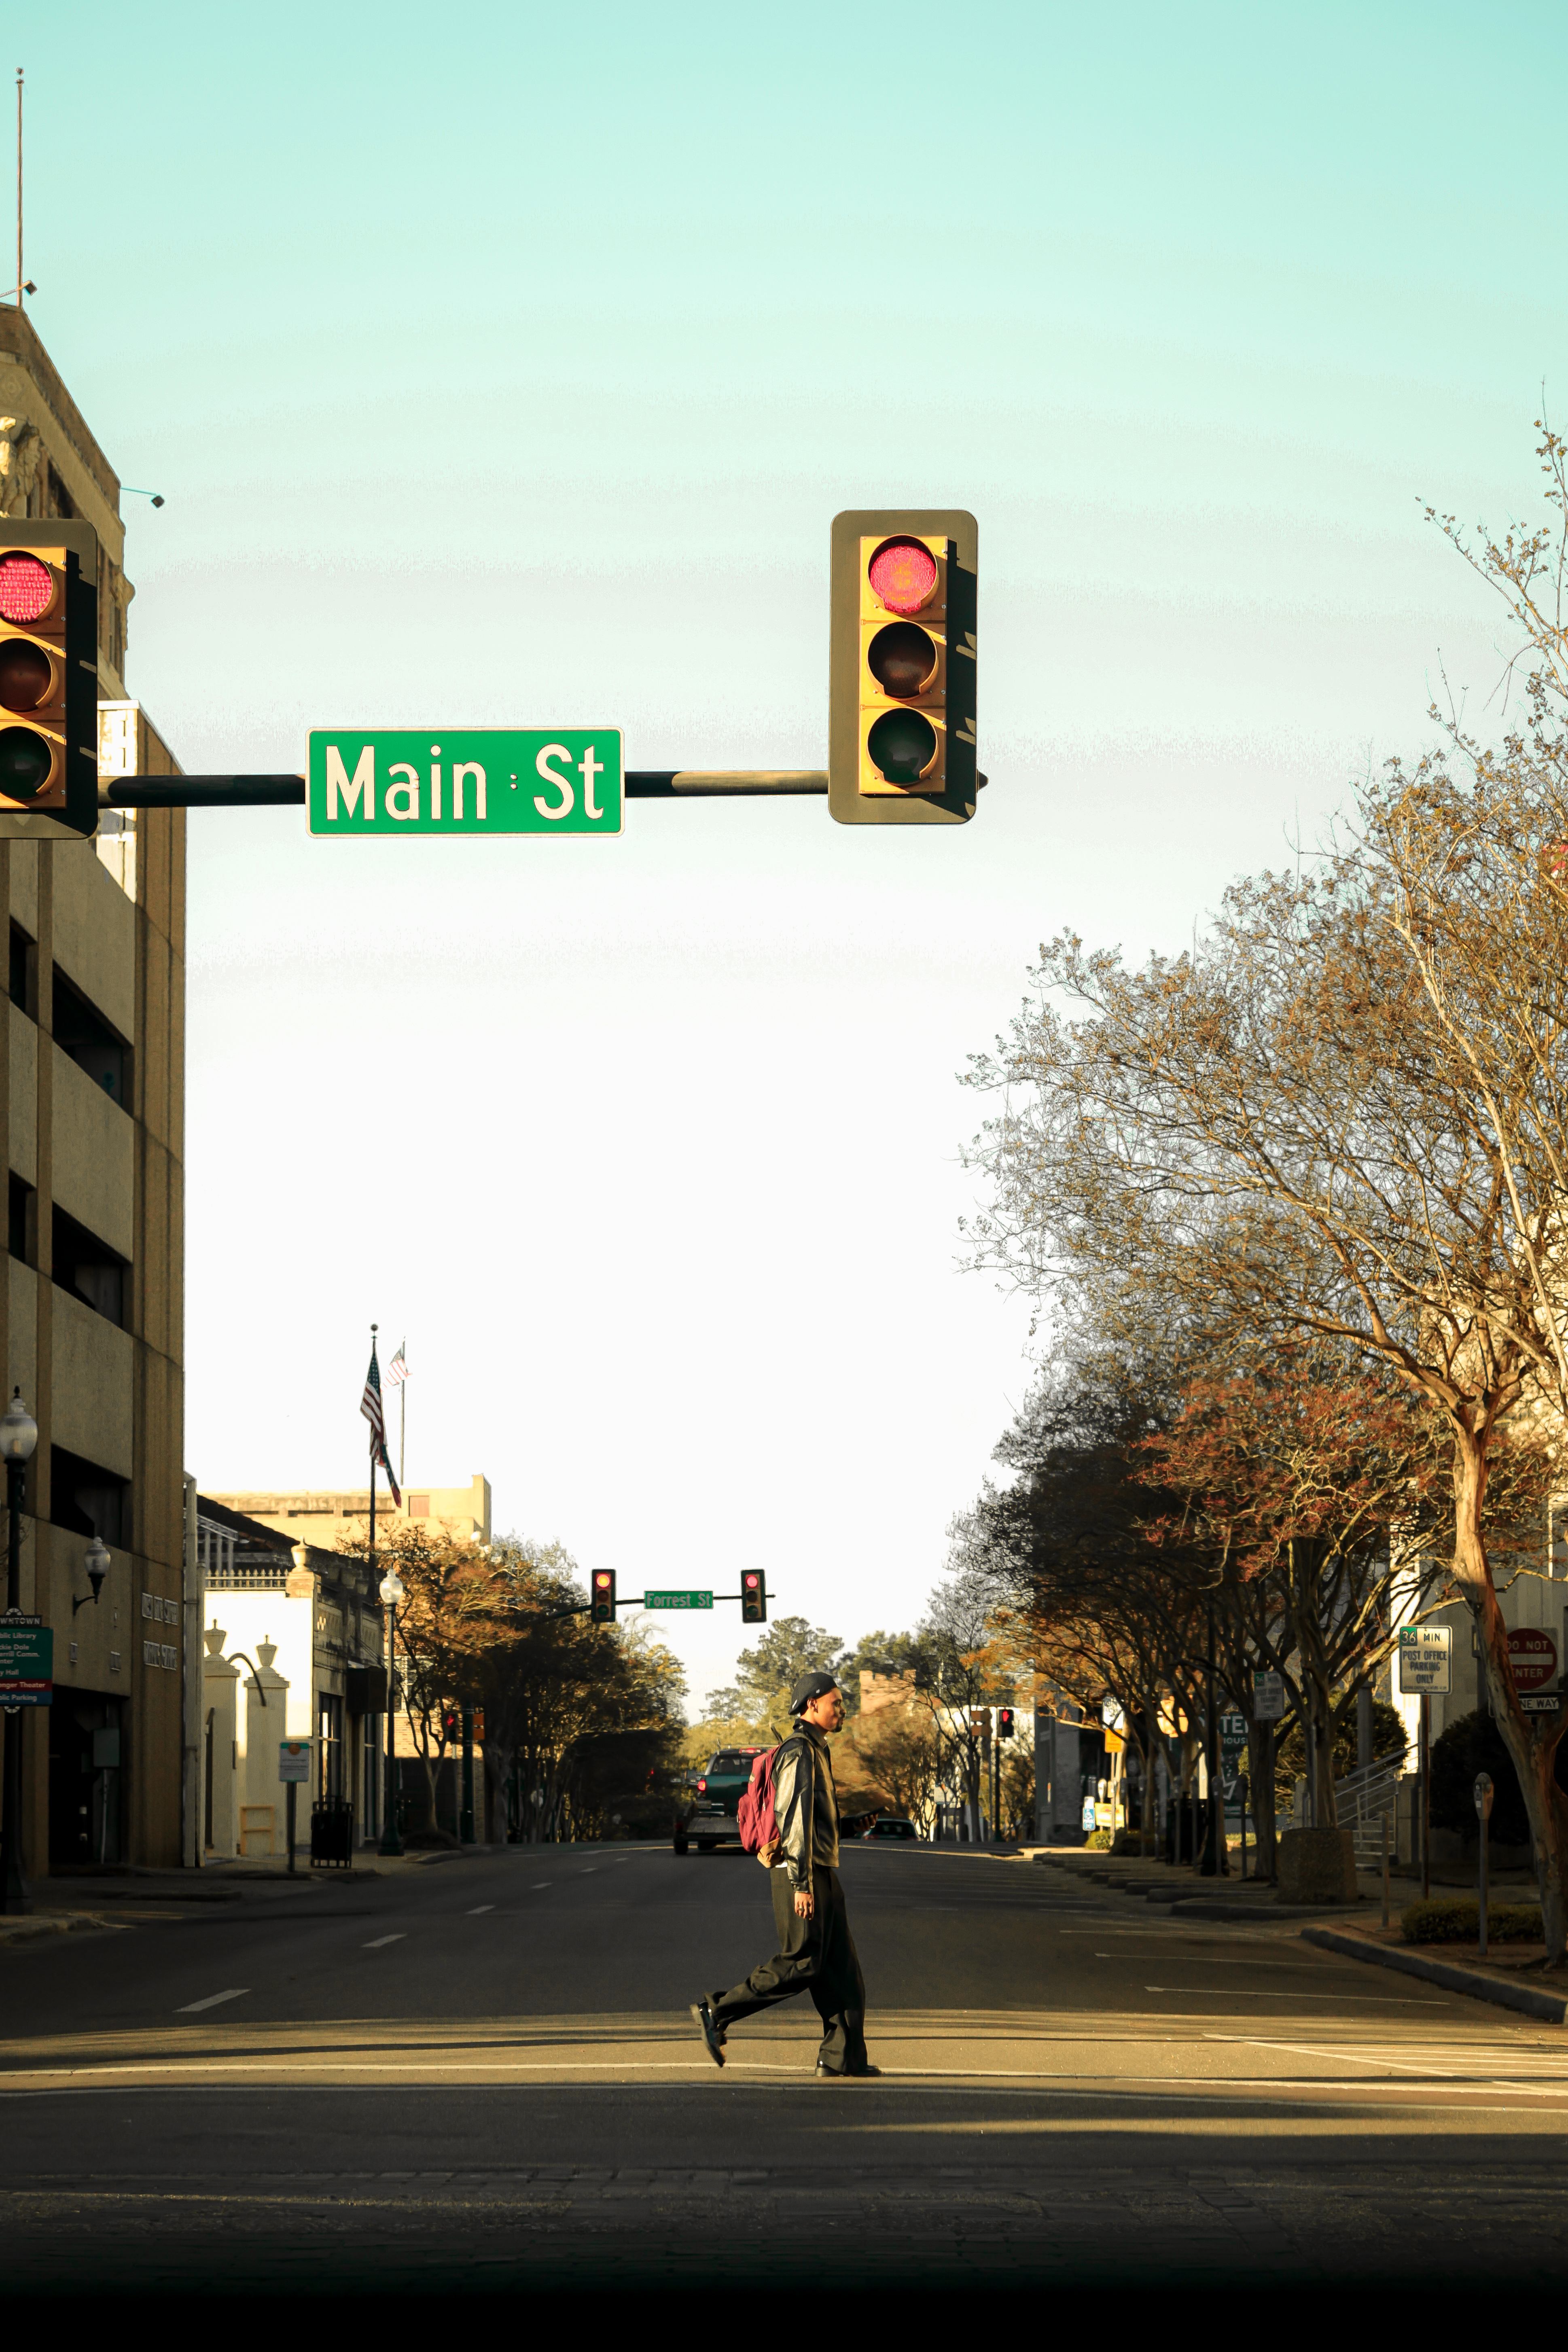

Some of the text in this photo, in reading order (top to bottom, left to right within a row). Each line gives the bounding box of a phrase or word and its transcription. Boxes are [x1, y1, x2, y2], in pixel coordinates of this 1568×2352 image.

[325, 742, 605, 821] Main St
[646, 1593, 711, 1607] Forrest St
[12, 1632, 37, 1640] Library
[1401, 1630, 1416, 1644] 36
[1526, 1640, 1548, 1650] NOT
[1403, 1651, 1447, 1661] POST OFFICE
[1410, 1661, 1440, 1671] PARKING
[1416, 1674, 1434, 1684] ONLY
[11, 1694, 37, 1702] Parking
[1520, 1698, 1557, 1709] NE WAY
